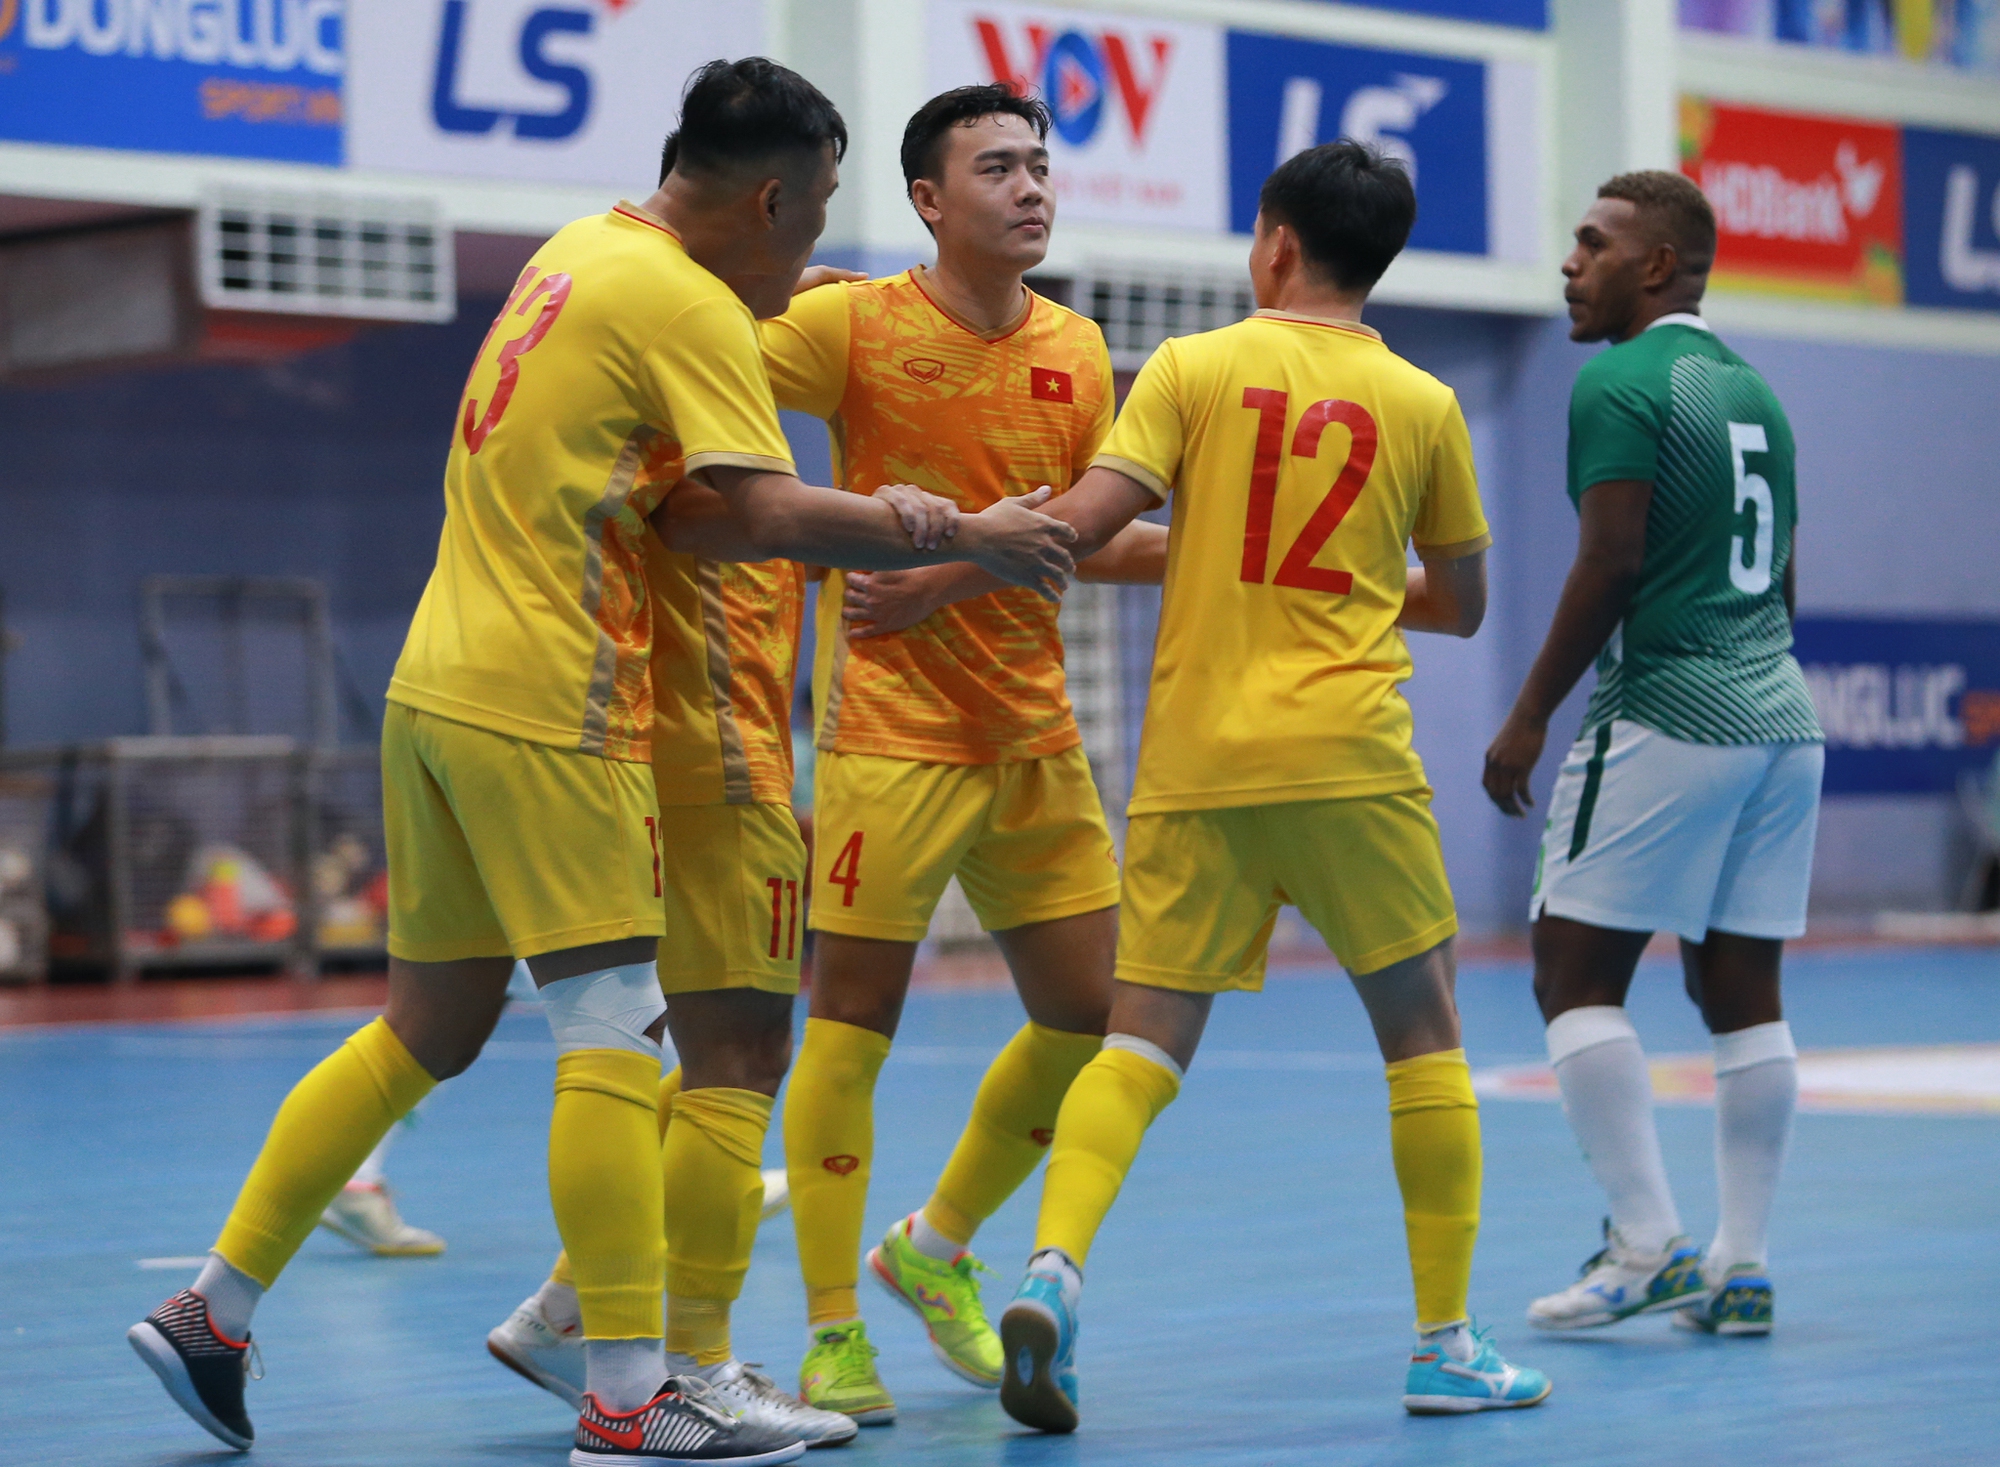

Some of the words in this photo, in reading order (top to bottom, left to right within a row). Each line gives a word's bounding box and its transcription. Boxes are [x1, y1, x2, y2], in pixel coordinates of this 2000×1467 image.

[434, 0, 592, 140] LS
[973, 18, 1172, 148] VOV
[1240, 386, 1378, 596] 12
[1727, 421, 1774, 595] 5
[766, 877, 797, 960] 11
[828, 830, 865, 907] 4
